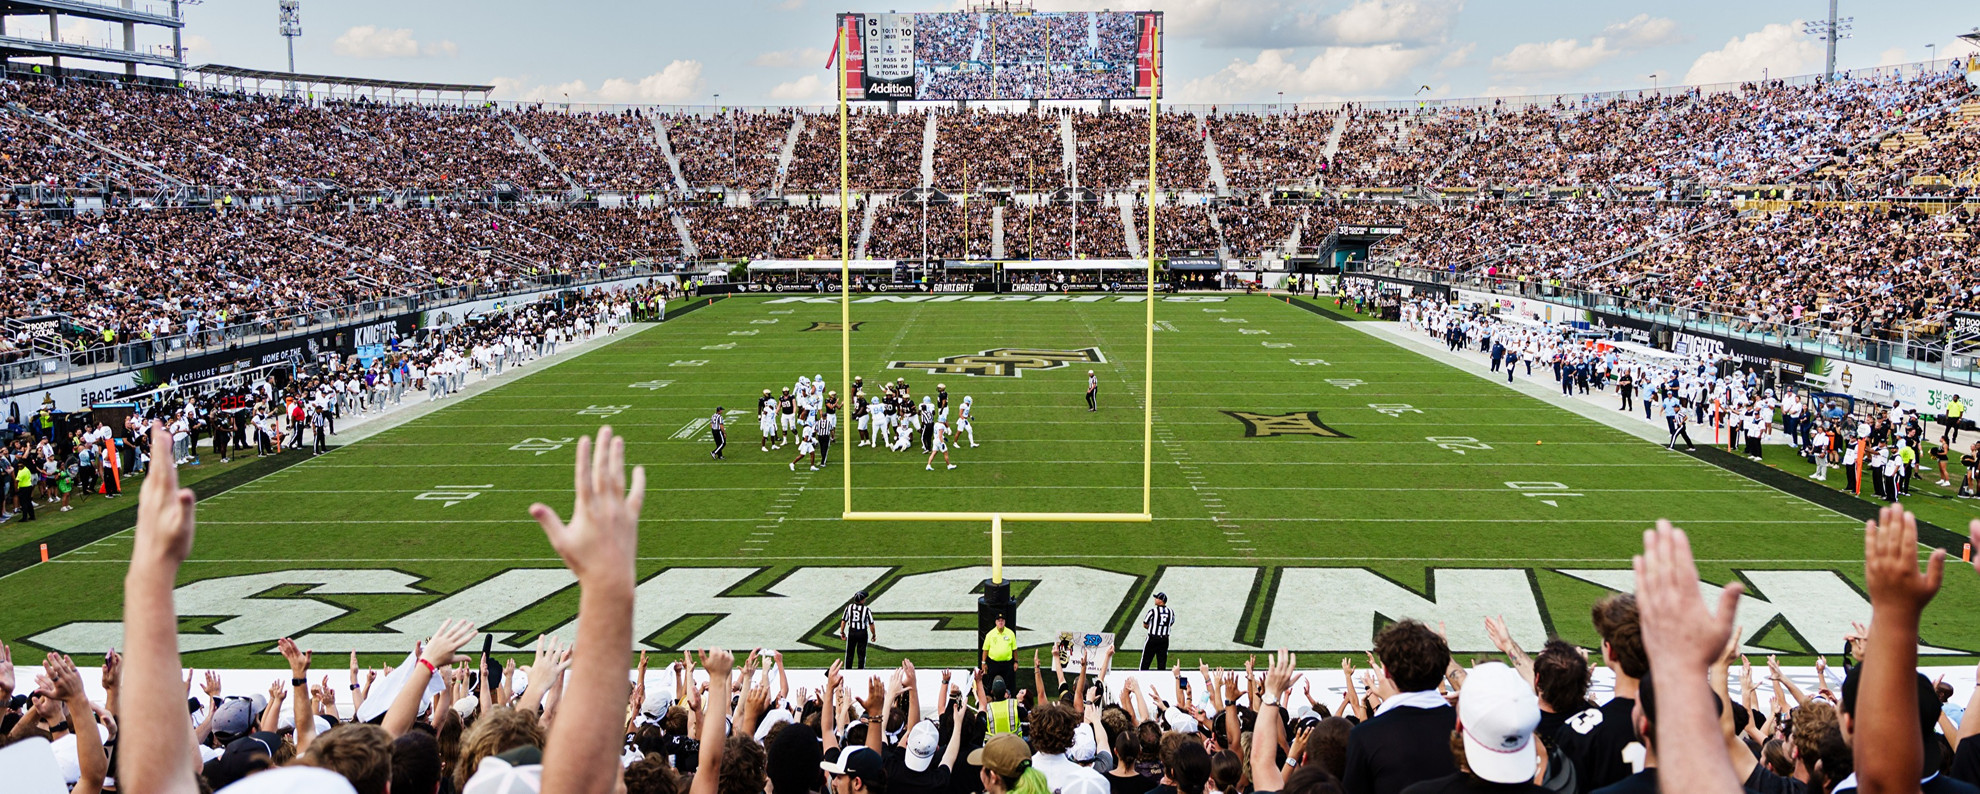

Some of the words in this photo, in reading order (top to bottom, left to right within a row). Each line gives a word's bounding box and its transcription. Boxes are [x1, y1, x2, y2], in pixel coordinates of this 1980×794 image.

[871, 28, 878, 36] 0
[901, 28, 912, 36] 10
[869, 82, 913, 94] Addition
[933, 283, 942, 292] GO
[943, 283, 974, 292] KNIGHTS
[31, 320, 59, 332] ROOFING
[354, 320, 397, 348] KNIGHTS
[1672, 331, 1724, 357] KNIGHTS
[262, 354, 280, 364] HOME
[280, 351, 289, 359] OF
[1952, 357, 1961, 368] 131
[44, 361, 56, 372] 108
[179, 367, 215, 382] ACRISURE
[508, 437, 575, 451] 20
[1425, 436, 1494, 450] 20
[414, 484, 494, 500] 10
[1504, 481, 1584, 496] 10
[852, 610, 860, 622] B
[1160, 613, 1169, 626] F
